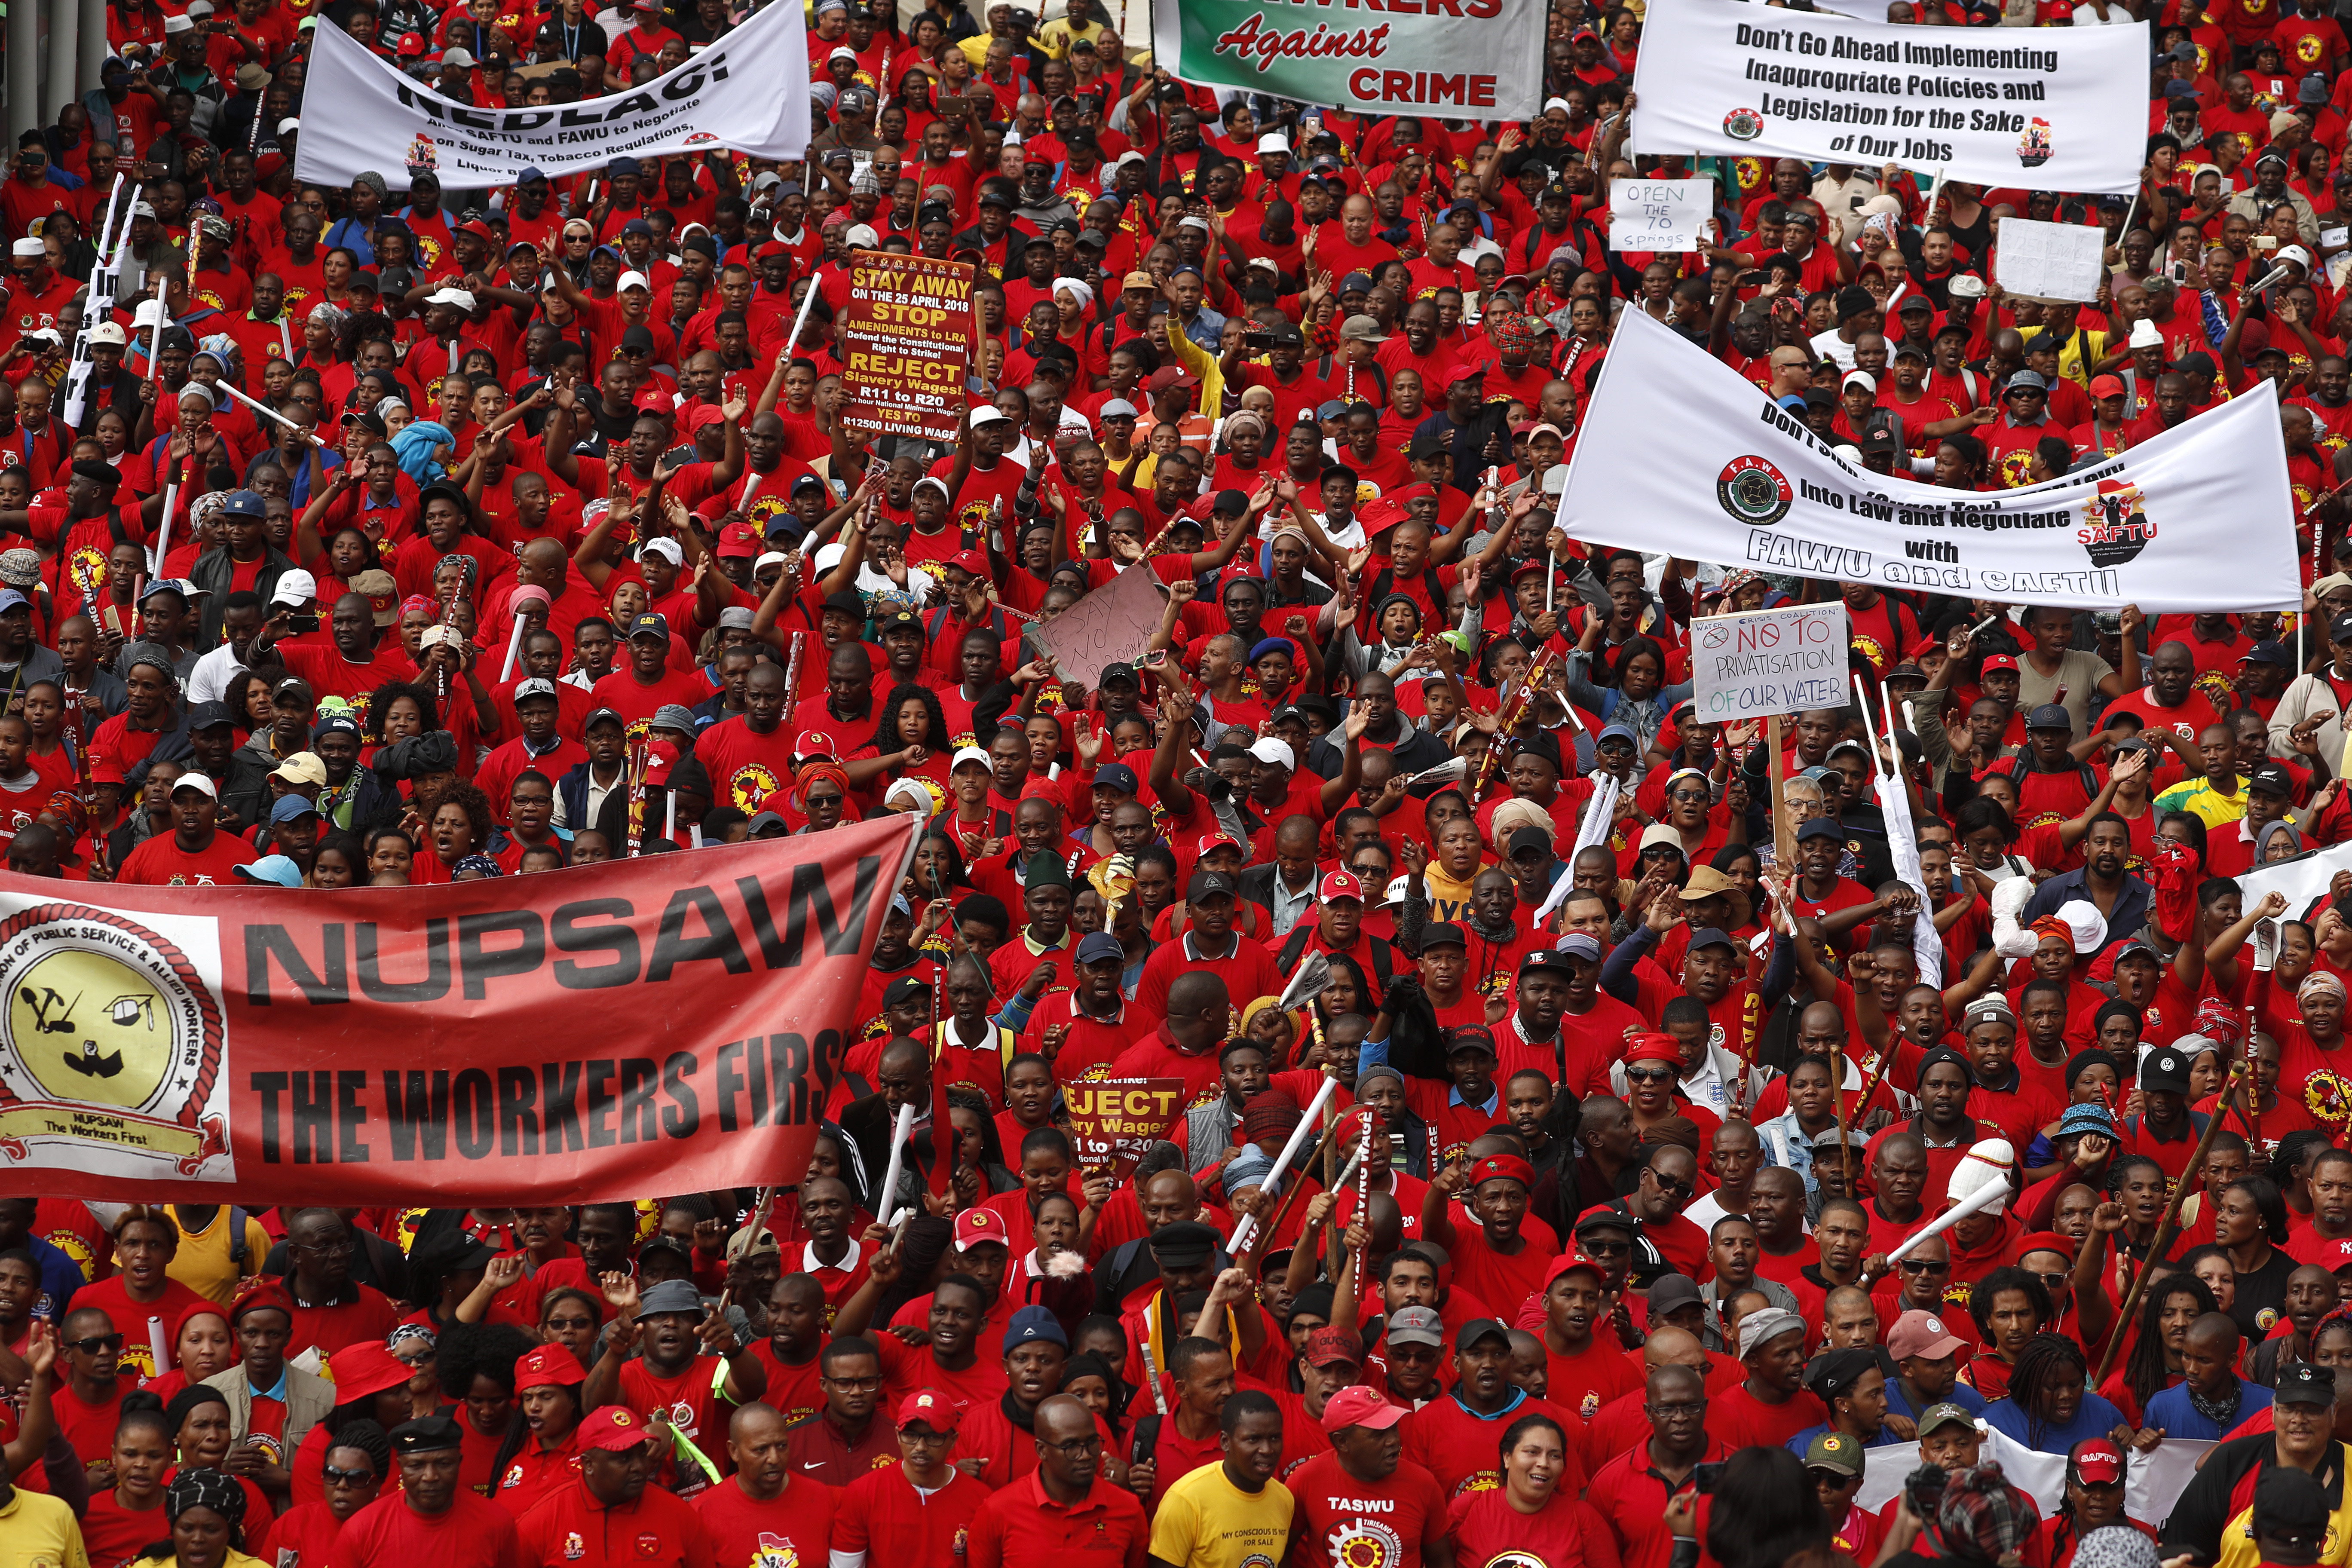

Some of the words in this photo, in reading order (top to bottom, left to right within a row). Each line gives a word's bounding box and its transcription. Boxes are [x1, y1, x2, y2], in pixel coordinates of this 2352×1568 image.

[1216, 14, 1390, 72] Against
[1736, 23, 1795, 52] Don't
[1798, 31, 1827, 57] Go
[1831, 35, 1900, 64] Ahead
[1905, 42, 2058, 72] Implementing
[1349, 69, 1497, 107] CRIME
[1746, 58, 1902, 95] Inappropriate
[1908, 75, 1999, 100] Policies
[2003, 80, 2045, 101] and
[466, 129, 522, 144] SAFTU
[527, 135, 553, 145] and
[558, 126, 609, 145] FAWU
[613, 124, 628, 135] to
[632, 98, 701, 129] Negotiate
[1761, 92, 1888, 126] Legislation
[1892, 105, 1925, 128] for
[1929, 108, 1965, 129] the
[1970, 110, 2025, 132] Sake
[436, 136, 454, 147] on
[459, 141, 502, 157] Sugar
[507, 149, 534, 163] Tax,
[537, 149, 601, 162] Tobacco
[606, 122, 694, 153] Regulations,
[1830, 135, 1855, 152] of
[1859, 135, 1898, 158] Our
[1902, 138, 1953, 162] Jobs
[2016, 147, 2055, 158] SAFTU
[404, 158, 440, 170] SAFTU
[457, 158, 503, 173] Liquor
[1628, 186, 1684, 202] OPEN
[1643, 204, 1670, 215] THE
[1648, 217, 1672, 230] 70
[852, 267, 906, 291] STAY
[911, 274, 971, 299] AWAY
[852, 288, 868, 299] ON
[871, 290, 892, 302] THE
[895, 293, 908, 304] 25
[910, 296, 941, 309] APRIL
[944, 299, 969, 312] 2018
[872, 302, 947, 326] STOP
[847, 331, 879, 342] Defend
[882, 335, 897, 343] the
[899, 337, 964, 352] Constitutional
[848, 320, 928, 337] AMENDMENTS
[931, 330, 942, 339] to
[945, 331, 966, 343] LRA
[872, 343, 897, 353] Right
[911, 347, 941, 358] Strike!
[850, 352, 961, 382] REJECT
[845, 371, 903, 389] Slavery
[907, 378, 962, 395] Wages!
[860, 386, 888, 399] R11
[894, 391, 910, 402] to
[915, 393, 944, 406] R20
[876, 400, 903, 409] National
[904, 404, 934, 413] Minimum
[877, 408, 900, 420] YES
[904, 411, 920, 422] TO
[843, 416, 881, 430] R12500
[885, 422, 922, 435] LIVING
[925, 427, 956, 440] WAGE
[1057, 428, 1090, 436] Jordan
[1729, 458, 1786, 492] F.A.W.U.
[1720, 492, 1730, 508] INJURY
[1801, 478, 1844, 509] Into
[1850, 493, 1893, 523] Law
[1899, 508, 1945, 527] and
[1951, 510, 2071, 531] Negotiate
[2077, 523, 2158, 544] SAFTU
[2314, 523, 2323, 558] WAGE
[1746, 528, 1871, 578] FAWU
[1883, 562, 1971, 589] and
[1981, 569, 2120, 597] SAFTU
[1905, 539, 1959, 563] with
[79, 564, 93, 603] WAGE
[1030, 620, 1064, 653] WE
[1069, 585, 1115, 637] SAY
[1739, 616, 1772, 625] CRISIS
[1737, 623, 1780, 652] NO
[1790, 614, 1830, 645] TO
[1069, 628, 1106, 672] NO
[1716, 644, 1834, 681] PRIVATISATION
[1710, 689, 1738, 713] OF
[1739, 685, 1777, 709] OUR
[242, 855, 882, 1006] NUPSAW
[15, 939, 30, 957] OF
[33, 927, 77, 943] PUBLIC
[81, 927, 138, 953] SERVICE
[138, 950, 148, 962] &
[149, 961, 185, 996] ALLIED
[181, 997, 199, 1068] WORKERS
[1743, 992, 1761, 1057] STAY
[251, 1068, 369, 1165] THE
[383, 1050, 699, 1163] WORKERS
[715, 1028, 848, 1133] FIRS
[1061, 1084, 1176, 1115] REJECT
[44, 1121, 66, 1133] The
[70, 1125, 118, 1141] Workers
[121, 1131, 147, 1145] First
[73, 1113, 124, 1129] NUPSAW
[1979, 1119, 1998, 1129] NUMSA
[1087, 1139, 1109, 1153] to
[1361, 1112, 1373, 1161] WAGE
[1428, 1125, 1439, 1173] WAGE
[2080, 1452, 2117, 1464] SAFTU
[1327, 1497, 1394, 1513] TASWU
[1234, 1528, 1271, 1537] CONSCIOUS
[1363, 1519, 1393, 1535] TIRISANO
[1243, 1538, 1256, 1547] FOR
